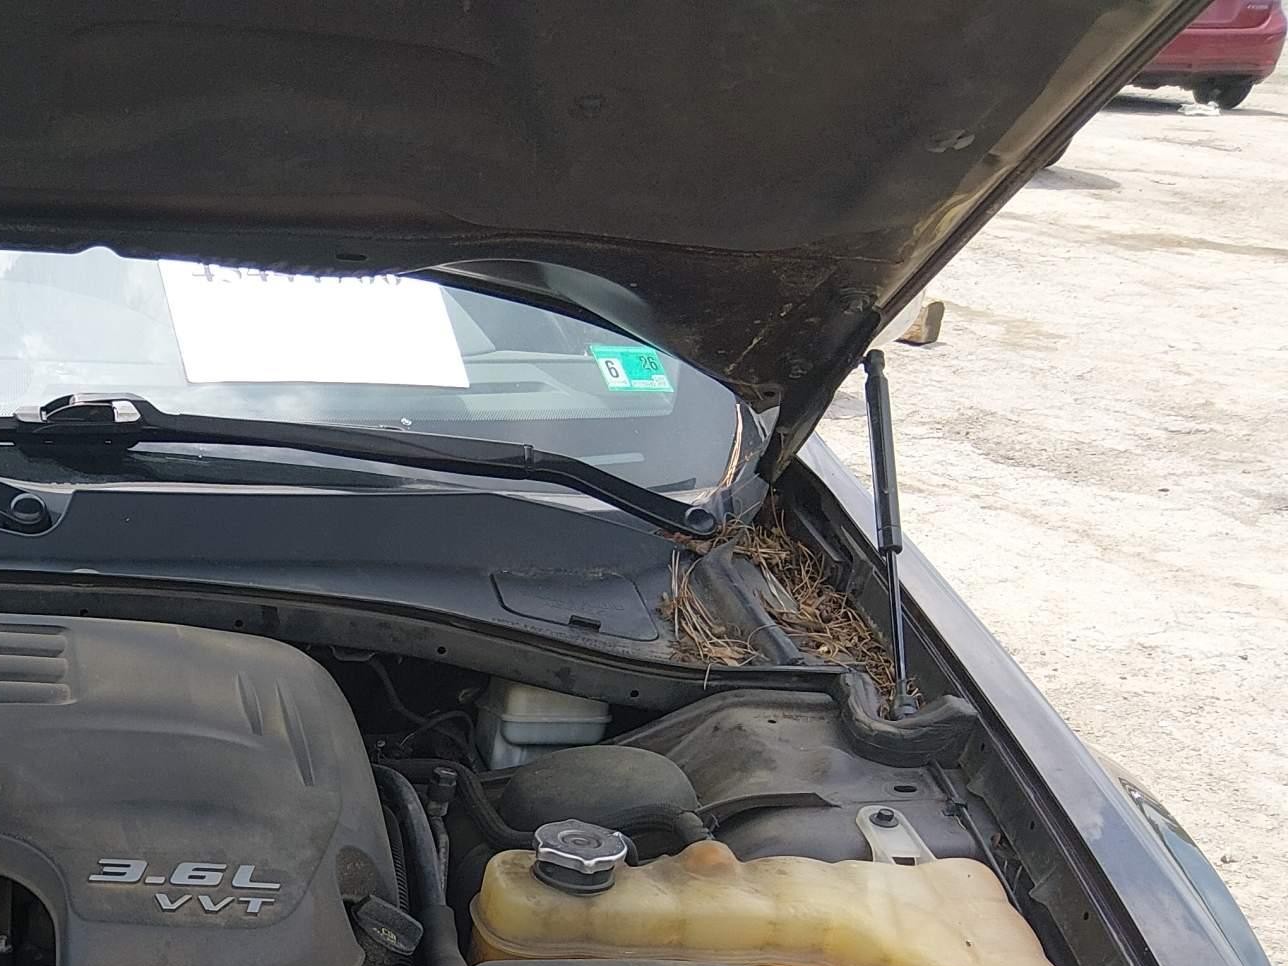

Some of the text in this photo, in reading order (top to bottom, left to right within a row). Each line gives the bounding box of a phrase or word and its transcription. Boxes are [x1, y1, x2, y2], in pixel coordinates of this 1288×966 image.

[604, 359, 620, 379] 6
[639, 355, 658, 371] 26
[88, 858, 282, 890] 3.6L
[154, 893, 276, 915] VVT
